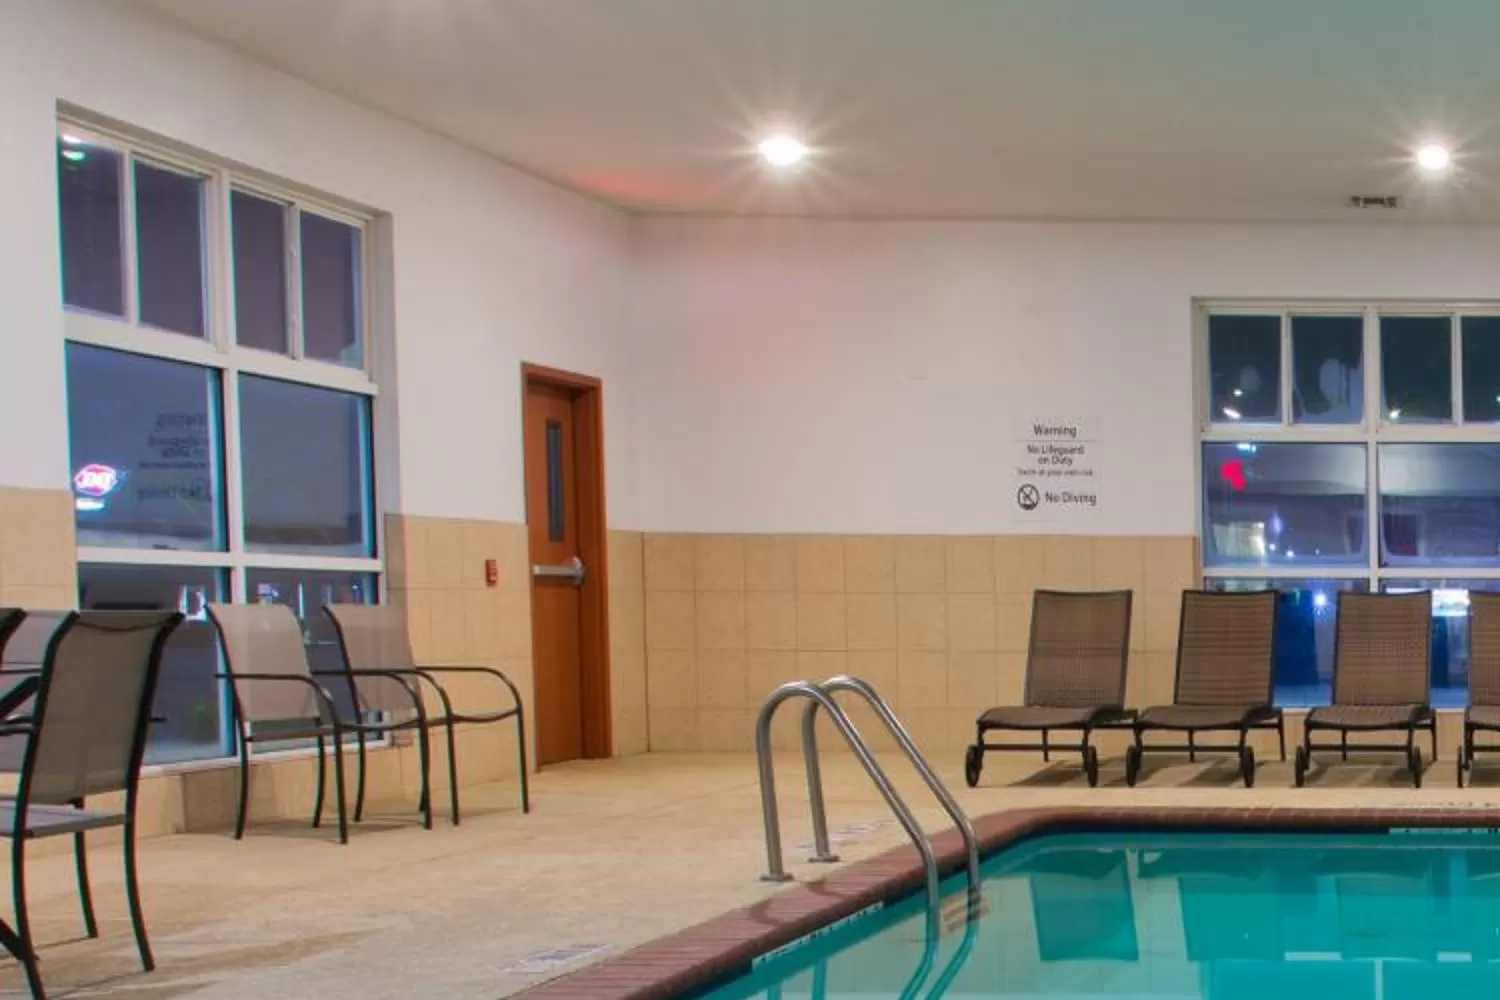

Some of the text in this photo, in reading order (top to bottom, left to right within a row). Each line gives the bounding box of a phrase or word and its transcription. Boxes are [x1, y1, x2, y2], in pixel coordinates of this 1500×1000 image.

[1034, 424, 1077, 438] Warning
[1027, 444, 1085, 456] No Lifeguard
[1051, 456, 1073, 466] Duty
[1045, 492, 1097, 507] No Diving
